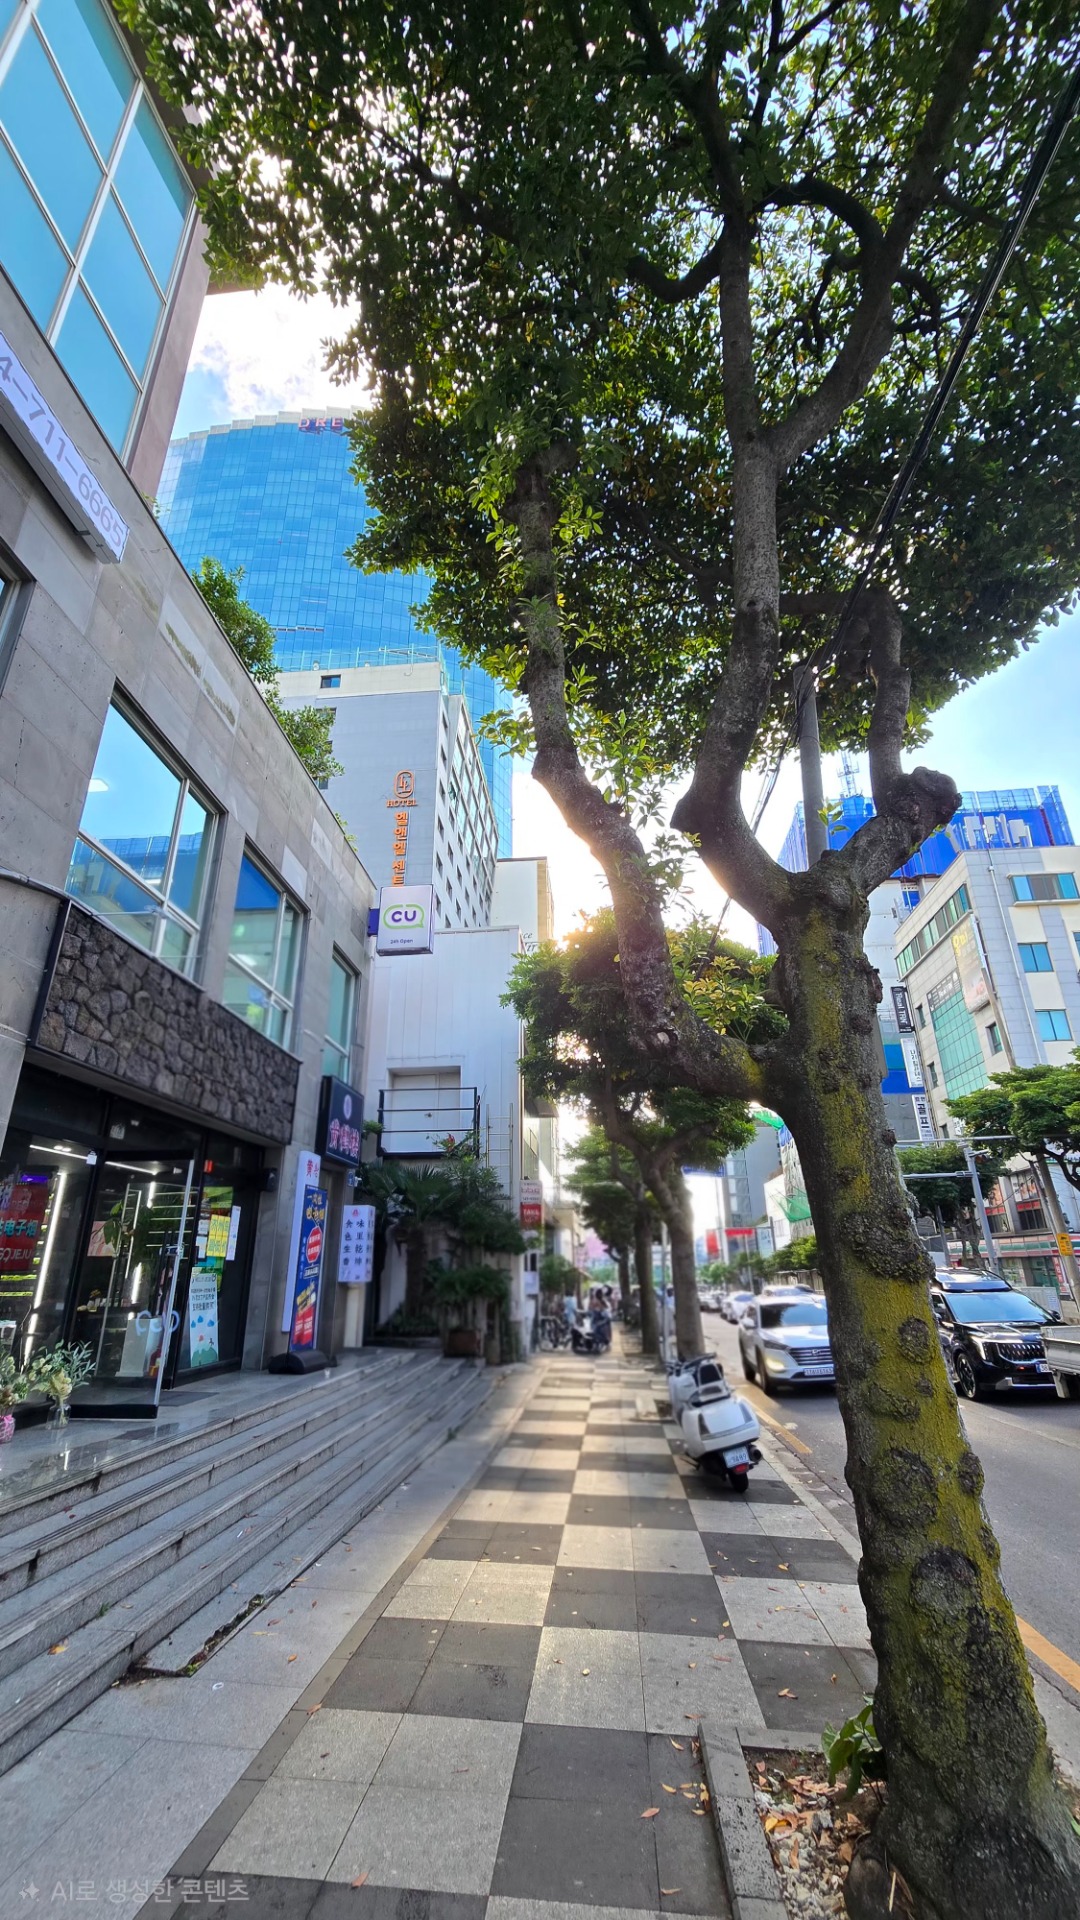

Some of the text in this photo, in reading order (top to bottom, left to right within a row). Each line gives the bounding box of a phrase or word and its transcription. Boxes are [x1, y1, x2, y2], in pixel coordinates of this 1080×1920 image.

[386, 799, 418, 808] HOTEL
[392, 859, 405, 887] 센트
[391, 910, 417, 922] CU
[917, 1103, 930, 1128] 골프
[11, 1248, 32, 1261] JEJU
